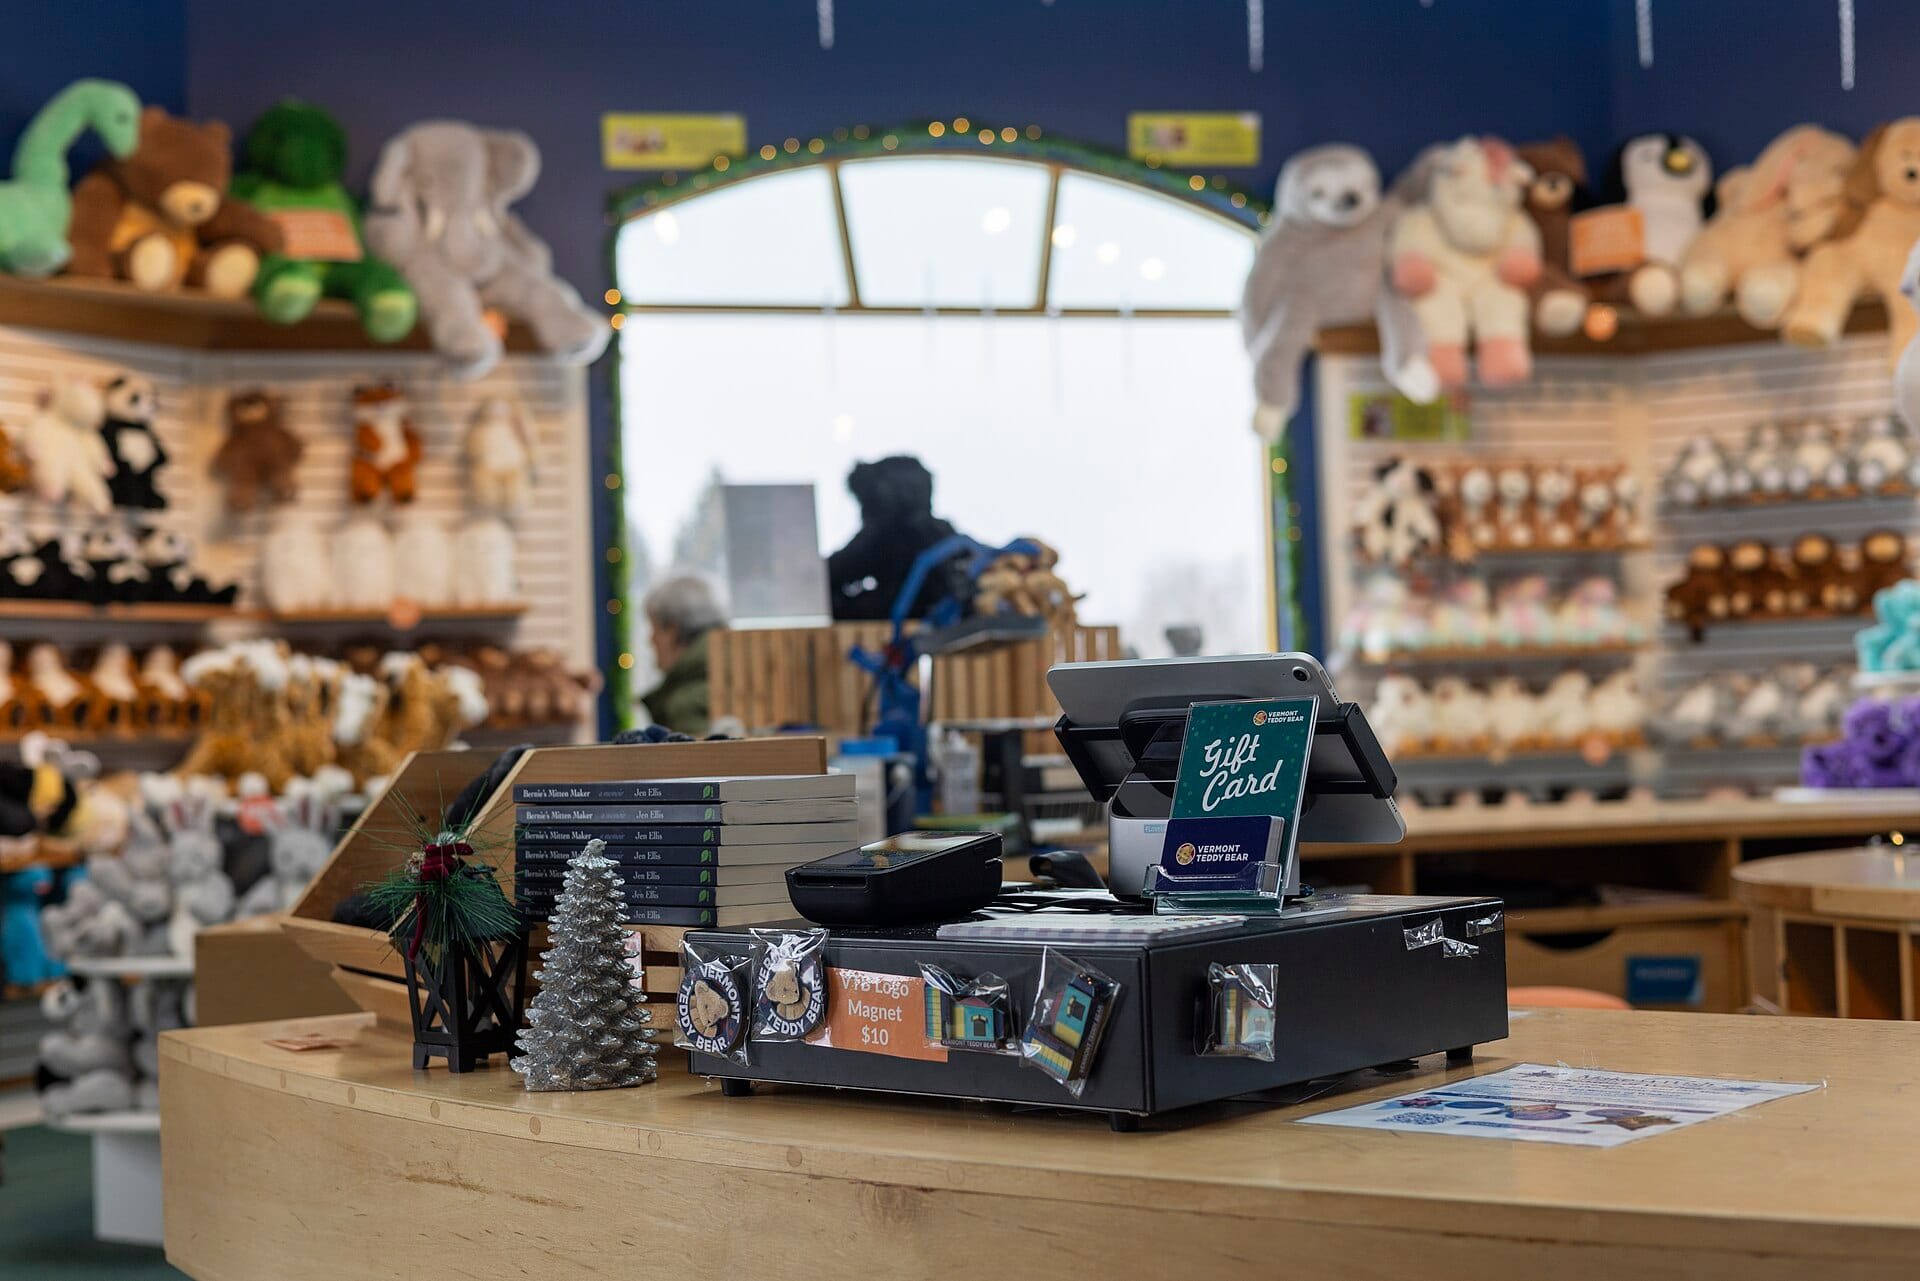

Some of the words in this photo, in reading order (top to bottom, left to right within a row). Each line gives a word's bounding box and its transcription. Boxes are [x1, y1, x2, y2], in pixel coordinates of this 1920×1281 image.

[1200, 733, 1261, 777] Gift
[1202, 759, 1284, 812] Card
[523, 789, 547, 798] Bernie's
[548, 789, 569, 798] Mitten
[570, 788, 591, 798] Maker
[634, 788, 647, 797] Jen
[648, 788, 662, 797] Ellis
[526, 811, 550, 820] Bernie's
[551, 811, 571, 820] Mitten
[572, 810, 593, 820] Maker
[636, 810, 649, 820] Jen
[650, 810, 664, 819] Ellis
[525, 831, 549, 840] Bernie's
[550, 831, 570, 840] Mitten
[571, 831, 592, 840] Maker
[635, 832, 648, 840] Jen
[649, 831, 663, 840] Ellis
[1197, 845, 1241, 853] VERMONT
[550, 850, 570, 859] Mitten
[634, 852, 647, 860] Jen
[648, 851, 661, 860] Ellis
[1196, 854, 1223, 862] TEDDY
[1225, 853, 1249, 861] BEAR
[633, 872, 646, 880] Jen
[646, 871, 660, 880] Ellis
[632, 890, 645, 899] Jen
[645, 890, 659, 899] Ellis
[633, 910, 646, 919] Jen
[647, 910, 661, 919] Ellis
[699, 965, 741, 1024] VERMONT
[875, 981, 910, 998] Logo
[678, 983, 697, 1037] TEDDY
[848, 999, 902, 1022] Magnet
[767, 1009, 805, 1036] TEDDY
[861, 1024, 889, 1046] $10
